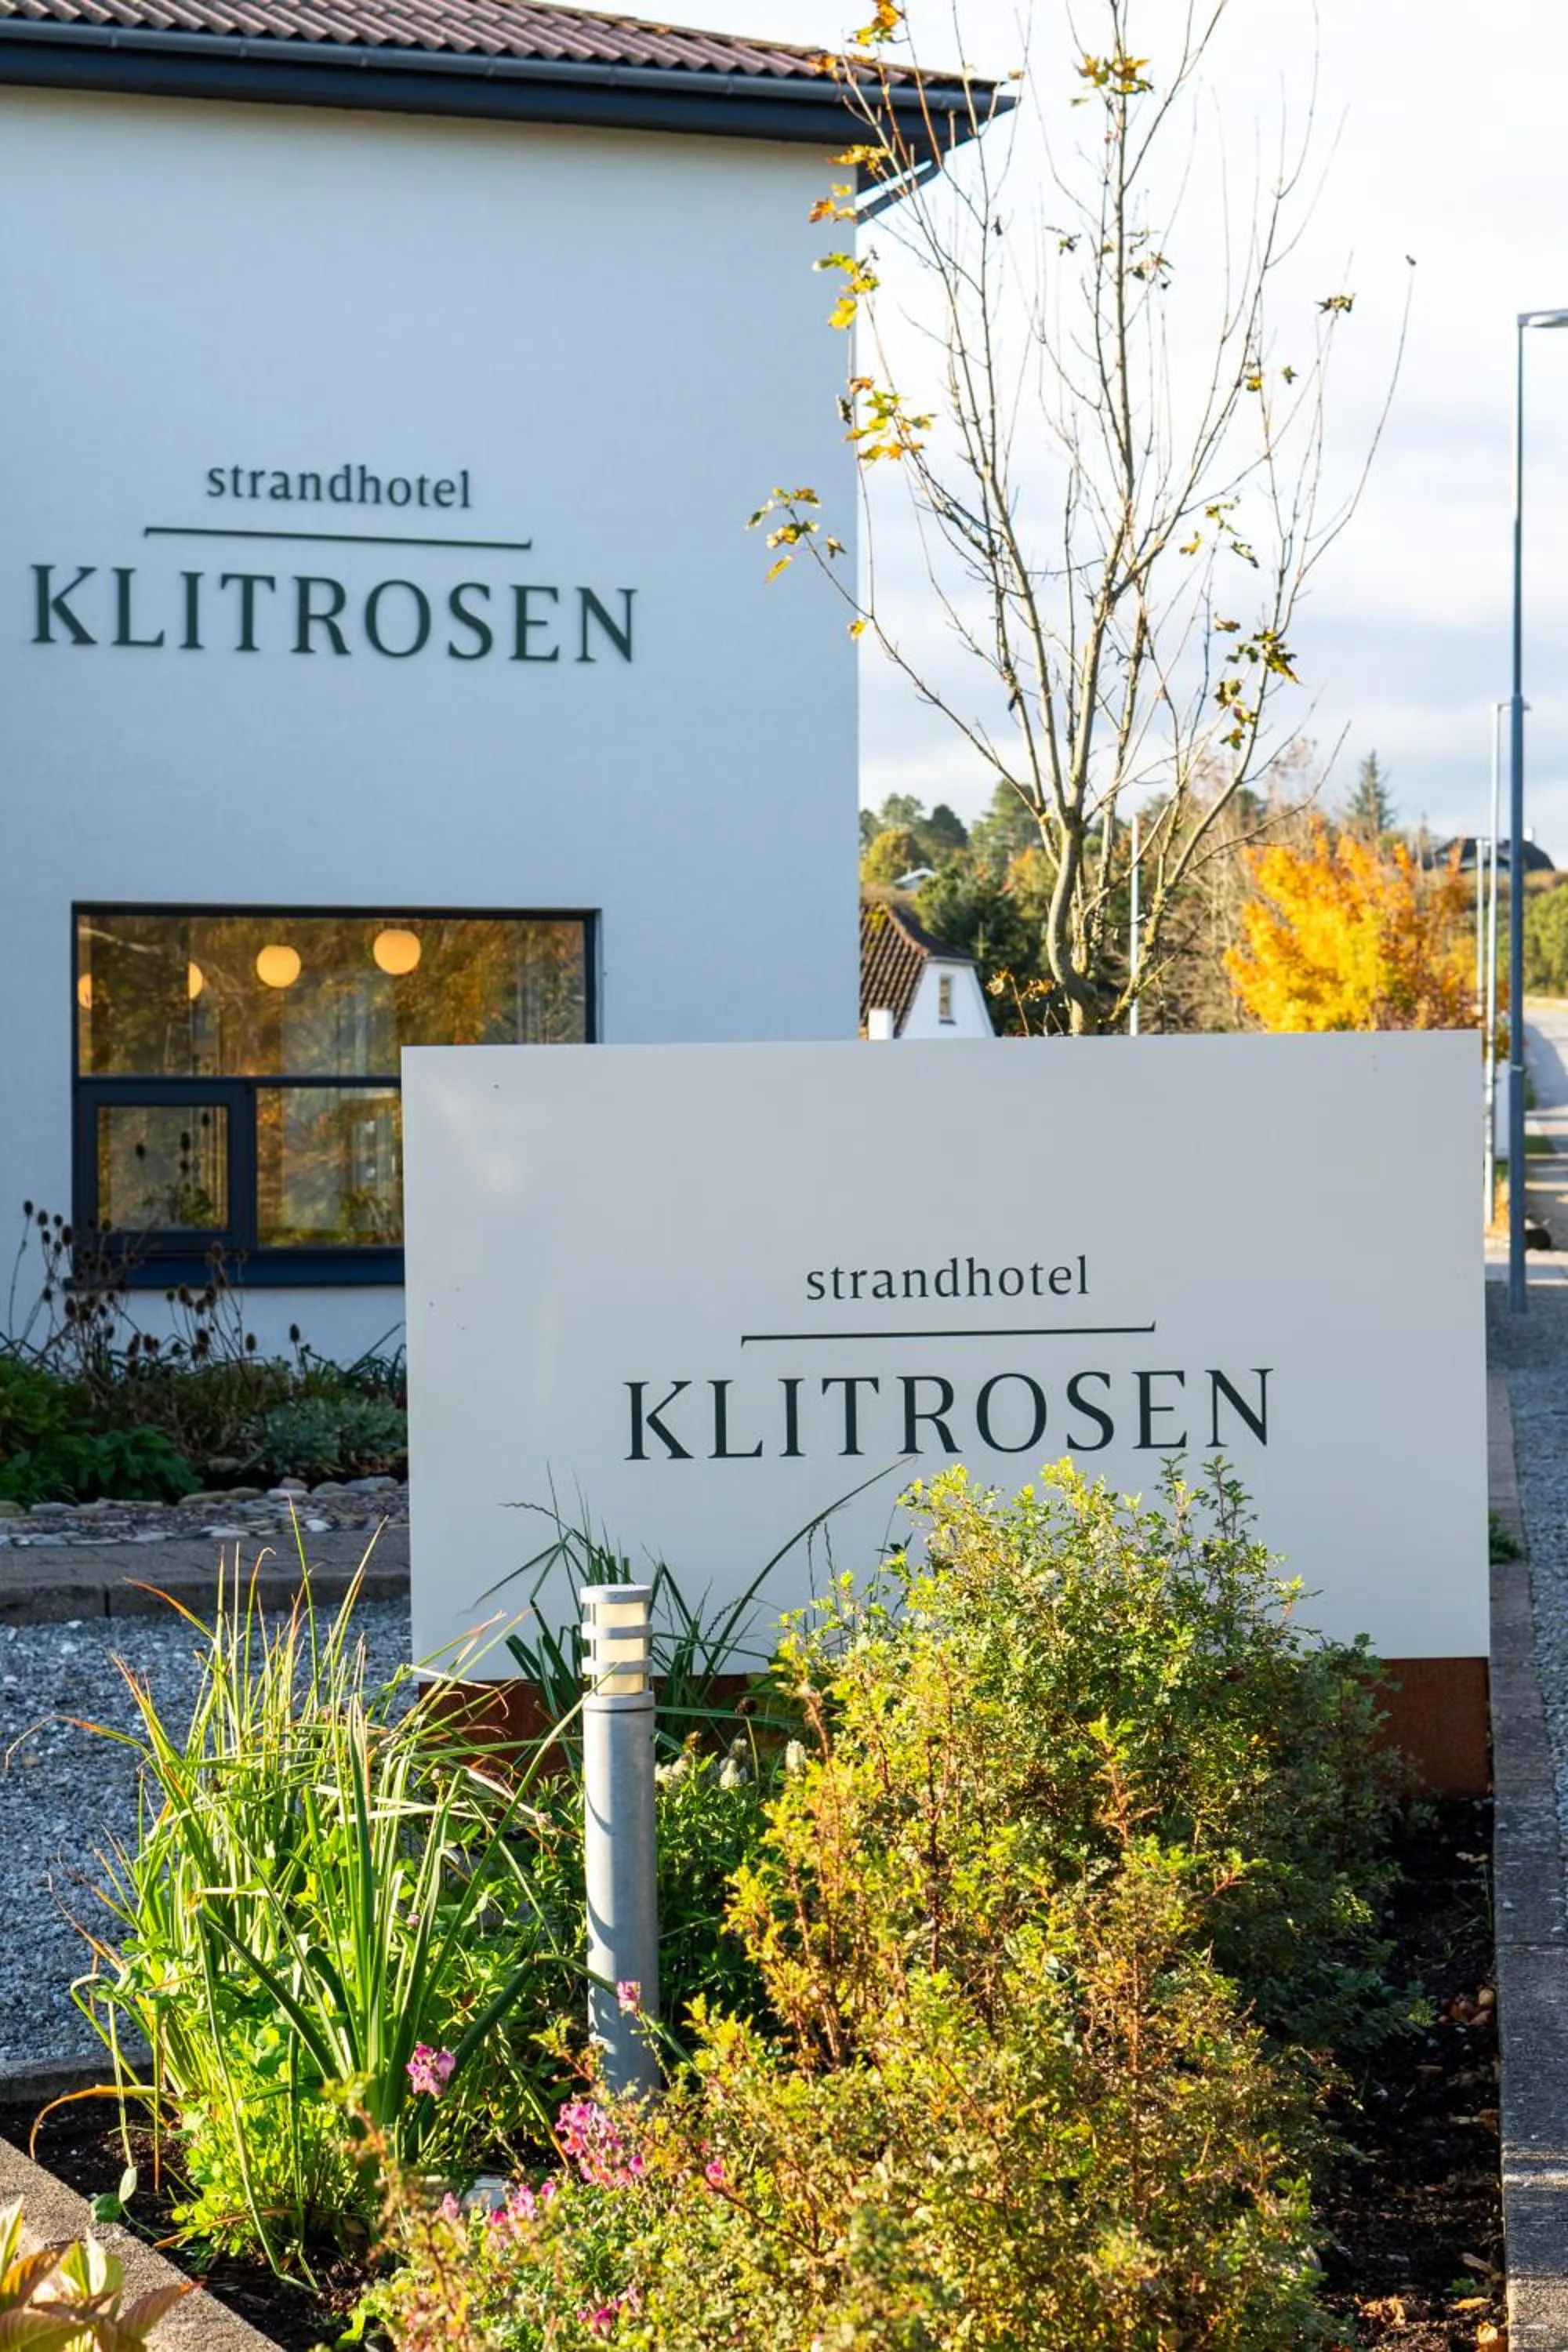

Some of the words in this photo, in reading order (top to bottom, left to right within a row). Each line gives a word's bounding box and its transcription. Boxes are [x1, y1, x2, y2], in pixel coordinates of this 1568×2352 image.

[206, 463, 472, 510] strandhotel
[30, 563, 638, 664] KLITROSEN
[806, 1254, 1090, 1301] strandhotel
[622, 1367, 1275, 1461] KLITROSEN
